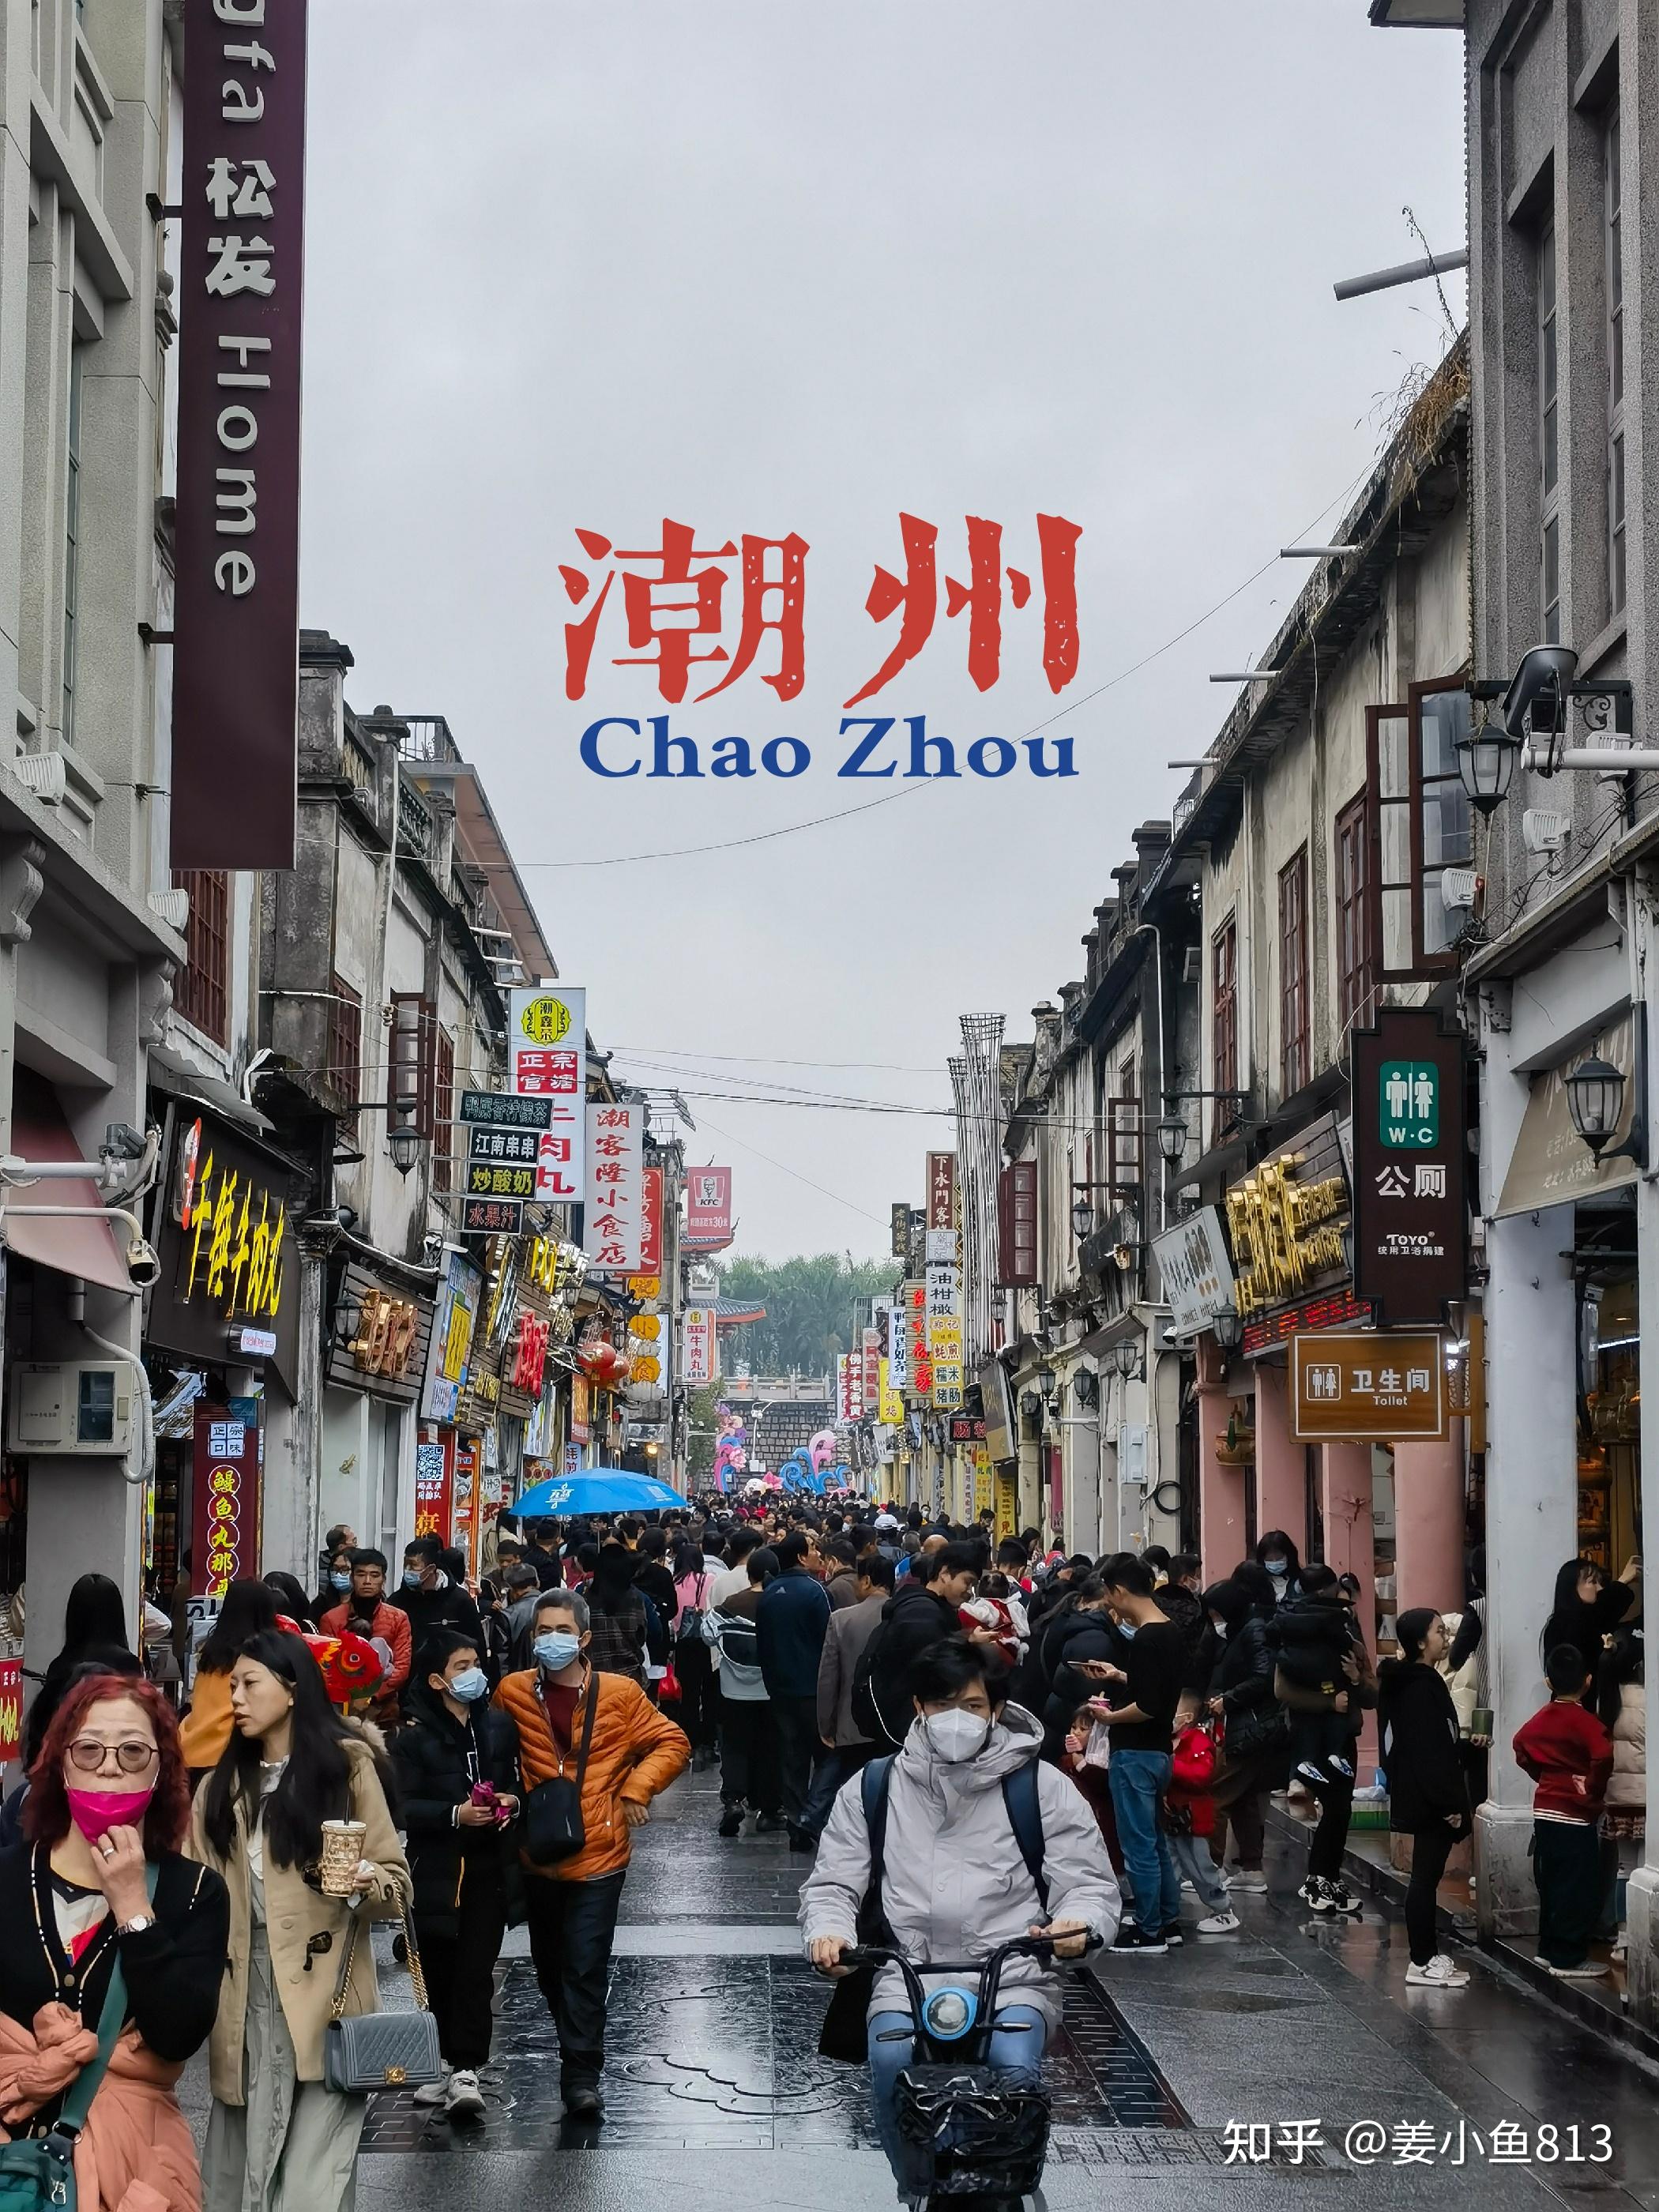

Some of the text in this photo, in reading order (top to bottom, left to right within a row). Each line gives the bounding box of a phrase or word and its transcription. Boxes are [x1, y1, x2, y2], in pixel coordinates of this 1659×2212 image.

[205, 157, 277, 298] 松发
[215, 335, 273, 597] Home
[520, 1052, 576, 1070] 正宗
[475, 1132, 535, 1159] 江南串串
[472, 1166, 532, 1194] 炒酸奶
[593, 1108, 631, 1265] 潮客隆小食店
[1375, 1164, 1446, 1198] 公厕
[468, 1202, 517, 1229] 水果汁
[690, 1335, 702, 1371] 牛肉丸
[1350, 1367, 1430, 1393] 卫生间
[1372, 1395, 1408, 1406] Toilet
[213, 1425, 243, 1437] 正宗
[213, 1443, 243, 1454] 口味
